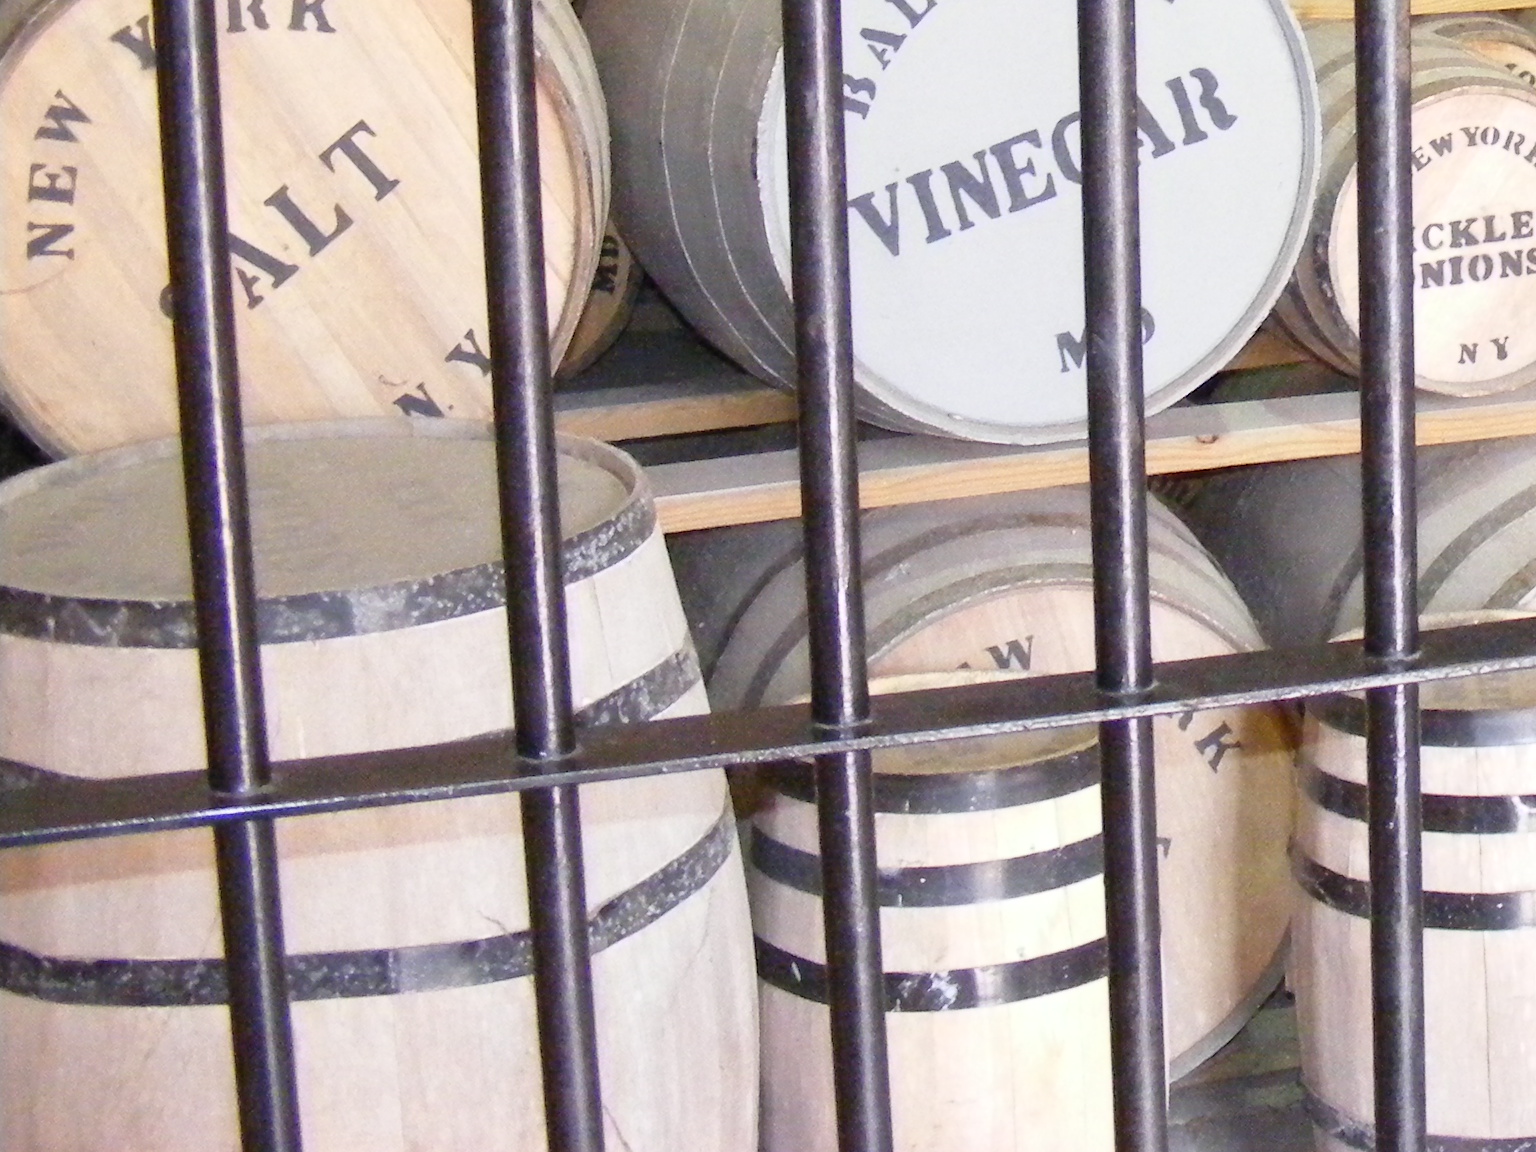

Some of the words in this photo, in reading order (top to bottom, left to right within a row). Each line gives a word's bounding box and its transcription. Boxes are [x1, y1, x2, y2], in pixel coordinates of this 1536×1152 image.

[27, 90, 92, 261] NEW
[1411, 131, 1453, 174] EW
[159, 119, 401, 321] ALT
[1458, 342, 1477, 364] N
[1491, 336, 1510, 360] Y
